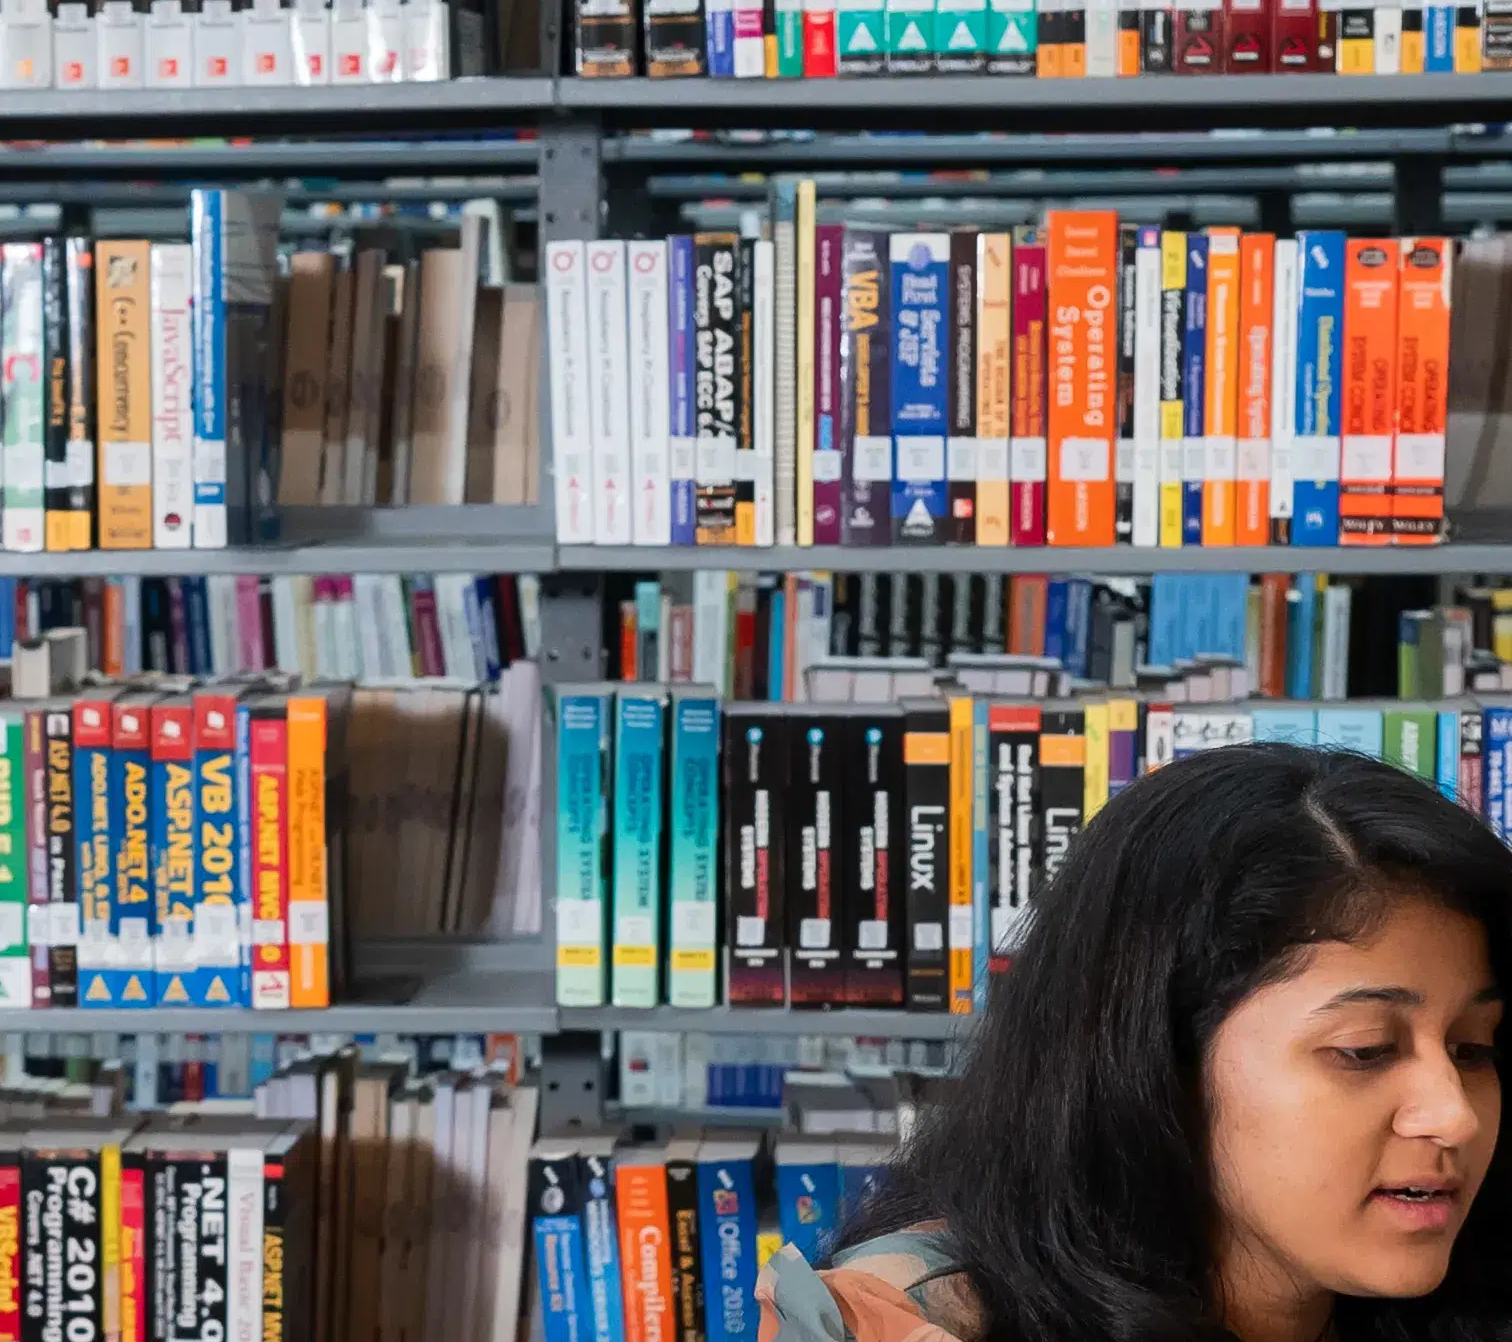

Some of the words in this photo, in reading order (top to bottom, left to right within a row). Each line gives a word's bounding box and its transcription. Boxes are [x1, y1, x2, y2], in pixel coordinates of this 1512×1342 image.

[114, 297, 134, 325] C++
[713, 252, 733, 318] SAP
[848, 271, 877, 330] VBA
[956, 265, 968, 326] SYSTEMS
[157, 307, 186, 441] JavaScript
[918, 310, 940, 384] Servlets
[957, 328, 970, 426] PROGRAMMING
[1056, 306, 1076, 406] System
[1083, 286, 1108, 425] Operating
[114, 332, 137, 433] Concurrency
[50, 741, 72, 803] ASP.NET
[202, 756, 231, 813] VB
[50, 805, 72, 833] 4.0
[126, 763, 147, 878] ADO.NET
[166, 764, 189, 895] ASP.NET
[257, 774, 277, 865] ASP.NET
[911, 805, 943, 890] Linux
[129, 885, 147, 902] 4
[27, 1190, 42, 1241] Covers
[66, 1167, 94, 1224] C#
[201, 1165, 224, 1264] .NET
[27, 1245, 42, 1282] .NET
[44, 1167, 66, 1342] Programming
[179, 1183, 200, 1327] Programming
[720, 1222, 740, 1281] Office
[27, 1288, 42, 1316] 4.0
[723, 1287, 744, 1332] 2010
